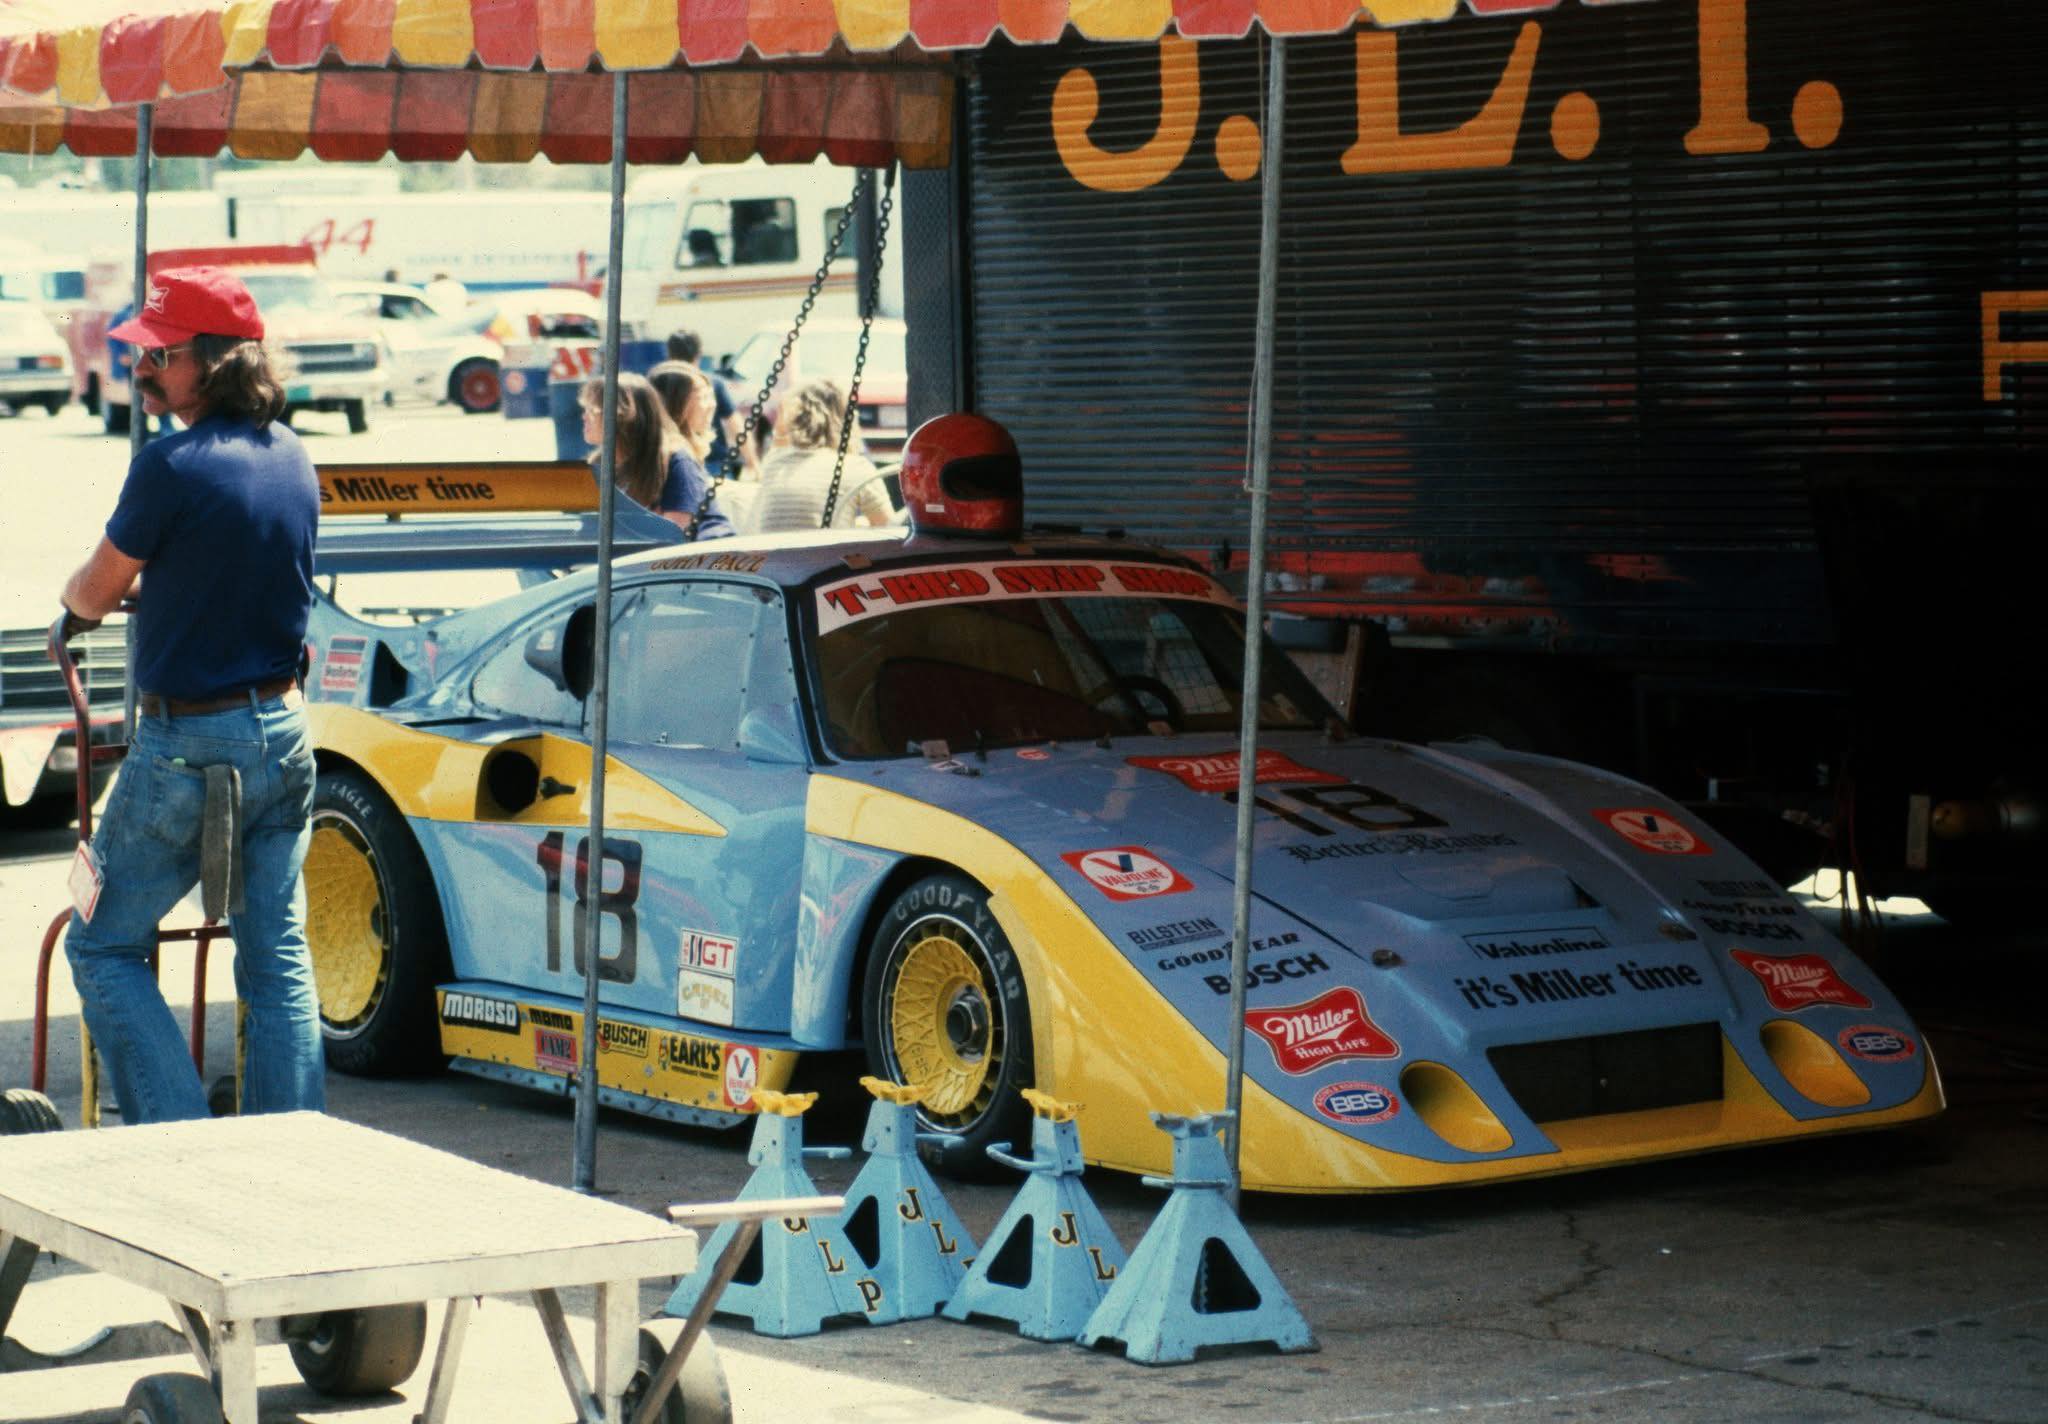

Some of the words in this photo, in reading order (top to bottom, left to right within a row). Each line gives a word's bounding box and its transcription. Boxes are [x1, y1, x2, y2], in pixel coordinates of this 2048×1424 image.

[333, 476, 418, 503] Miller
[426, 475, 495, 500] time
[823, 568, 991, 617] T-BIRD
[992, 565, 1106, 594] SWAP
[1159, 755, 1279, 777] Mier
[536, 830, 643, 985] 18
[1127, 917, 1218, 945] BILSTEIN
[703, 940, 734, 969] GT
[1157, 932, 1301, 971] GOODEAR
[1453, 976, 1520, 1010] it's
[1509, 967, 1617, 1004] Miller
[1616, 959, 1703, 992] time
[1752, 960, 1829, 986] Miller
[443, 993, 518, 1028] MOROSO
[602, 1022, 648, 1049] BUSCH
[1263, 1008, 1355, 1047] Miller
[669, 1035, 721, 1072] EARL'S
[1852, 1035, 1902, 1051] BBS
[1329, 1092, 1385, 1114] BBS
